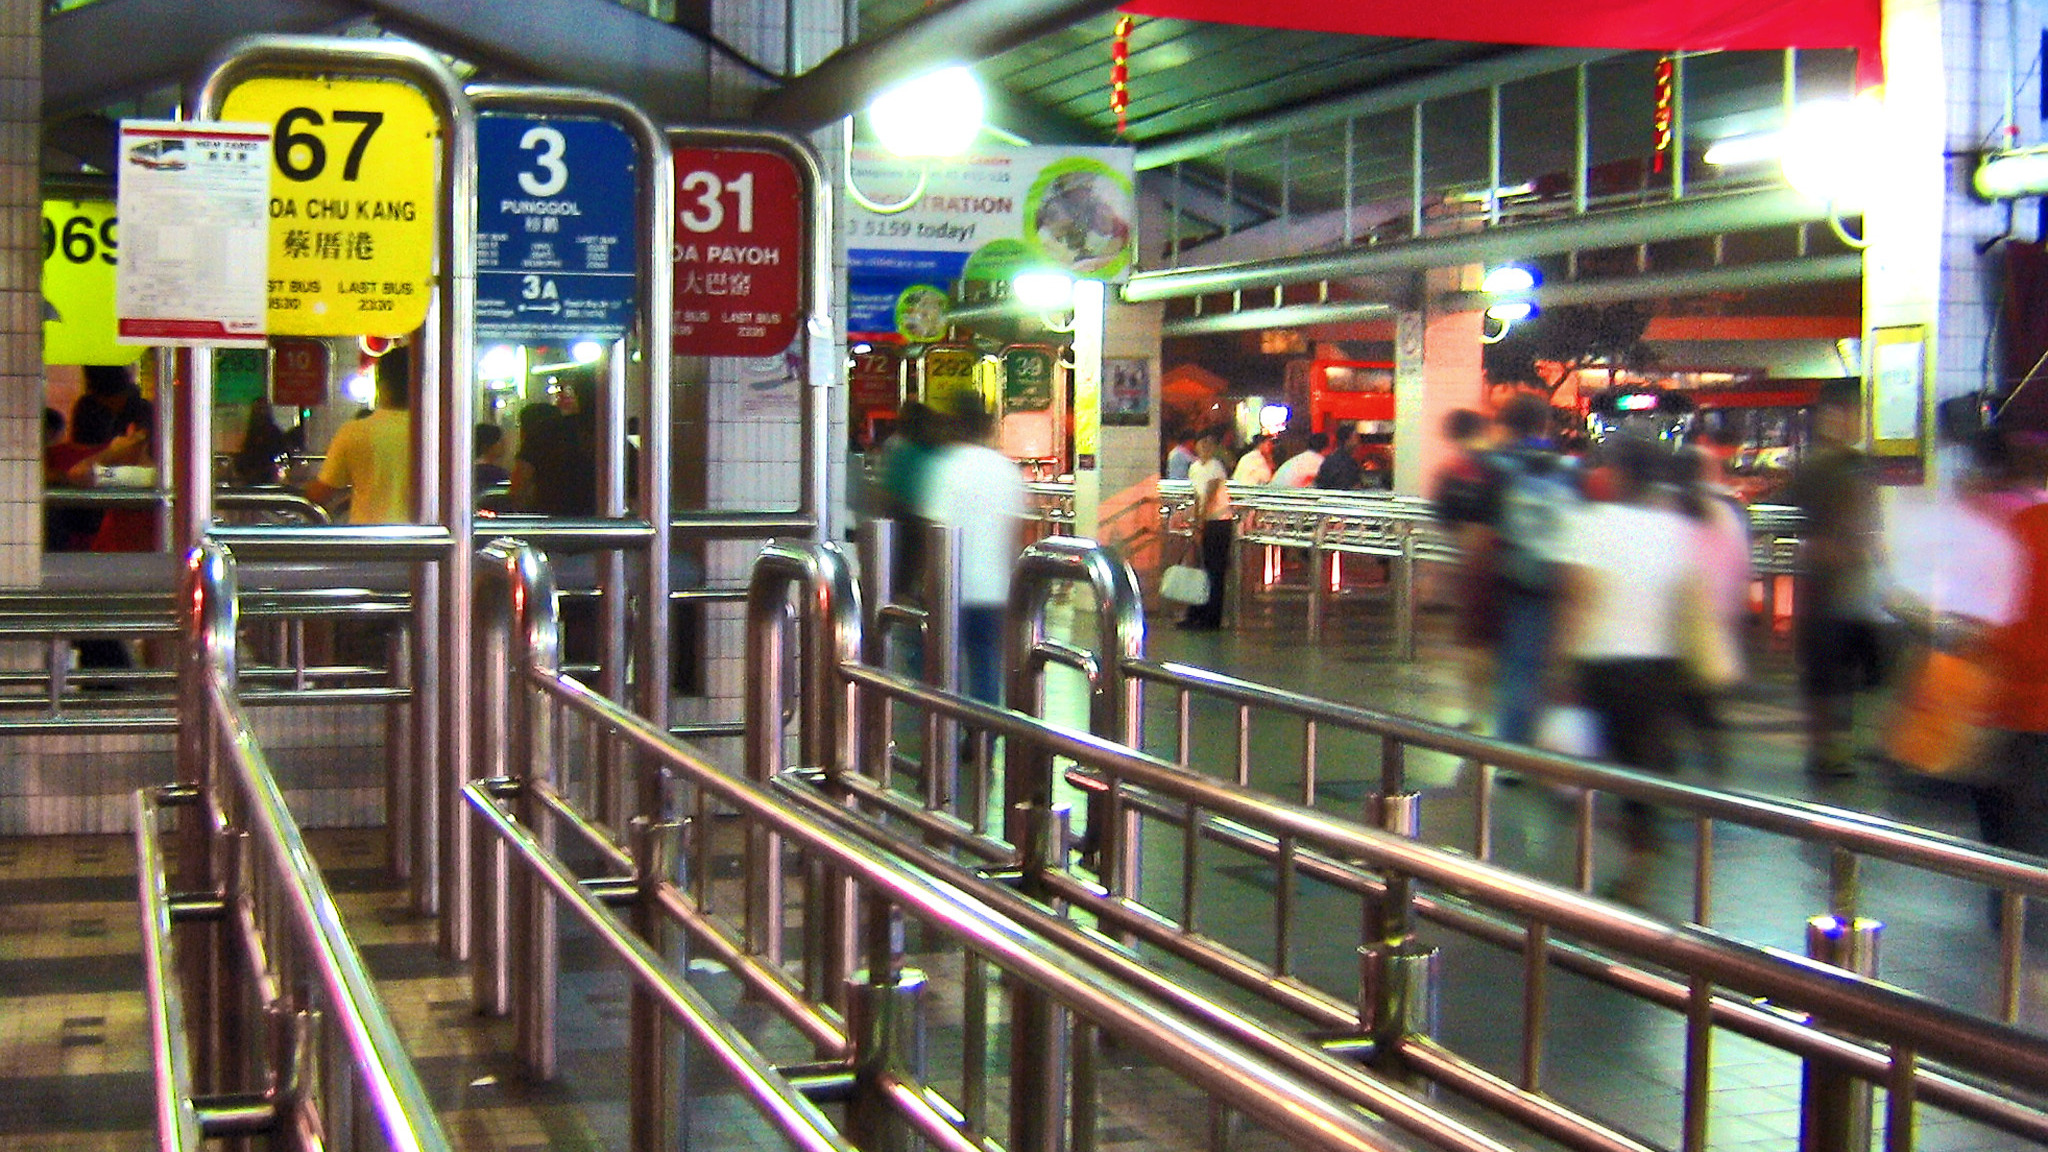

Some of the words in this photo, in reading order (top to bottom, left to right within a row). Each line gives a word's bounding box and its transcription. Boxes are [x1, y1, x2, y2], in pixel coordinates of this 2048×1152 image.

[274, 107, 384, 183] 67
[517, 127, 569, 197] 3
[306, 198, 350, 220] CHU
[356, 200, 417, 222] KANG
[500, 200, 583, 216] PUNGGOL
[680, 171, 754, 234] 31
[916, 222, 976, 242] today!
[706, 246, 780, 266] PAYOH
[289, 280, 322, 294] BUS
[337, 280, 377, 295] LAST
[381, 281, 415, 296] BUS
[521, 274, 559, 301] 3A
[864, 355, 888, 373] 72
